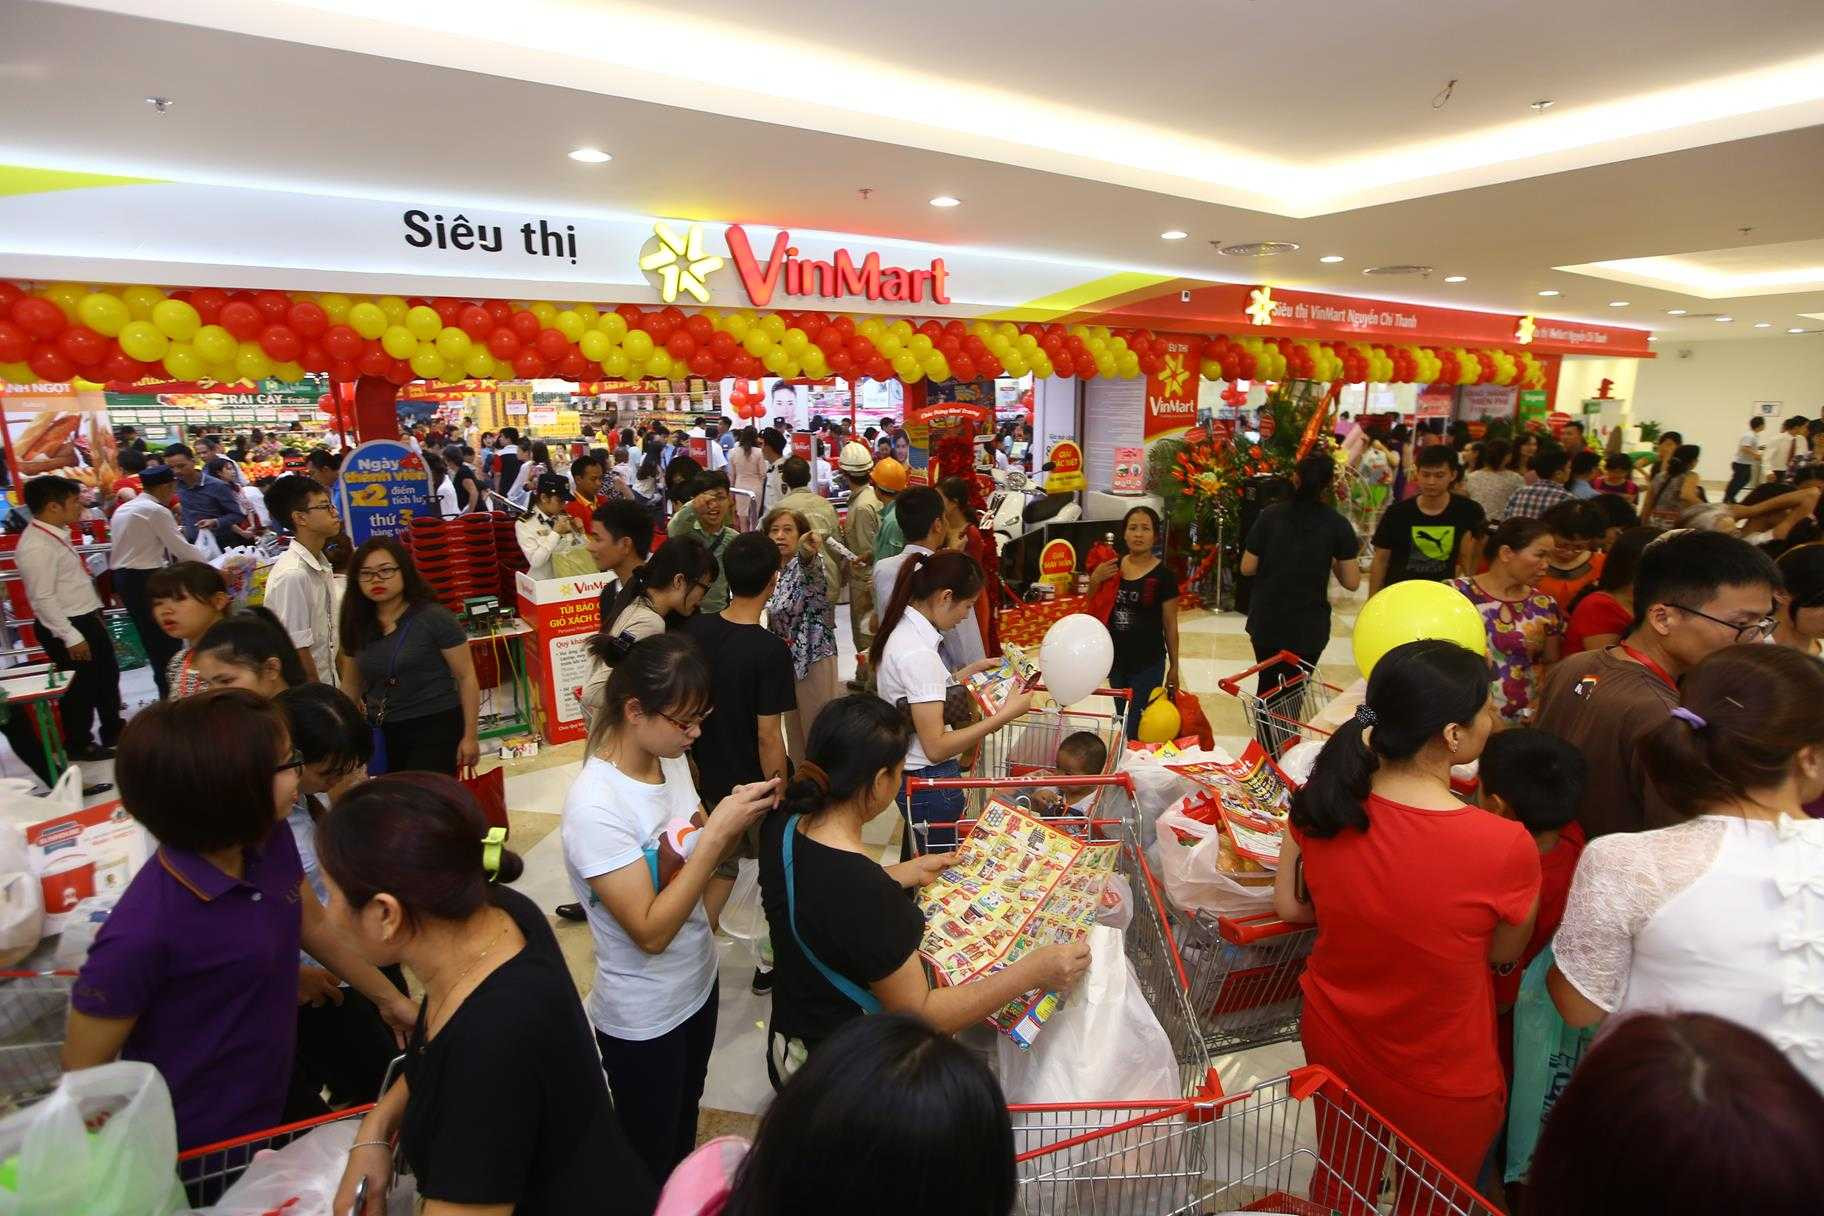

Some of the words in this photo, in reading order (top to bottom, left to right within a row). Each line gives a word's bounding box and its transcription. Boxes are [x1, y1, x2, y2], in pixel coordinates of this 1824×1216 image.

[404, 209, 503, 252] Siêu
[520, 219, 577, 265] thị
[725, 224, 951, 307] VinMart
[1311, 305, 1346, 323] VinMart
[1395, 313, 1417, 329] Thanh
[1150, 395, 1194, 416] VinMart
[358, 457, 400, 471] Ngày
[369, 512, 396, 527] thứ
[574, 581, 609, 594] VinMa
